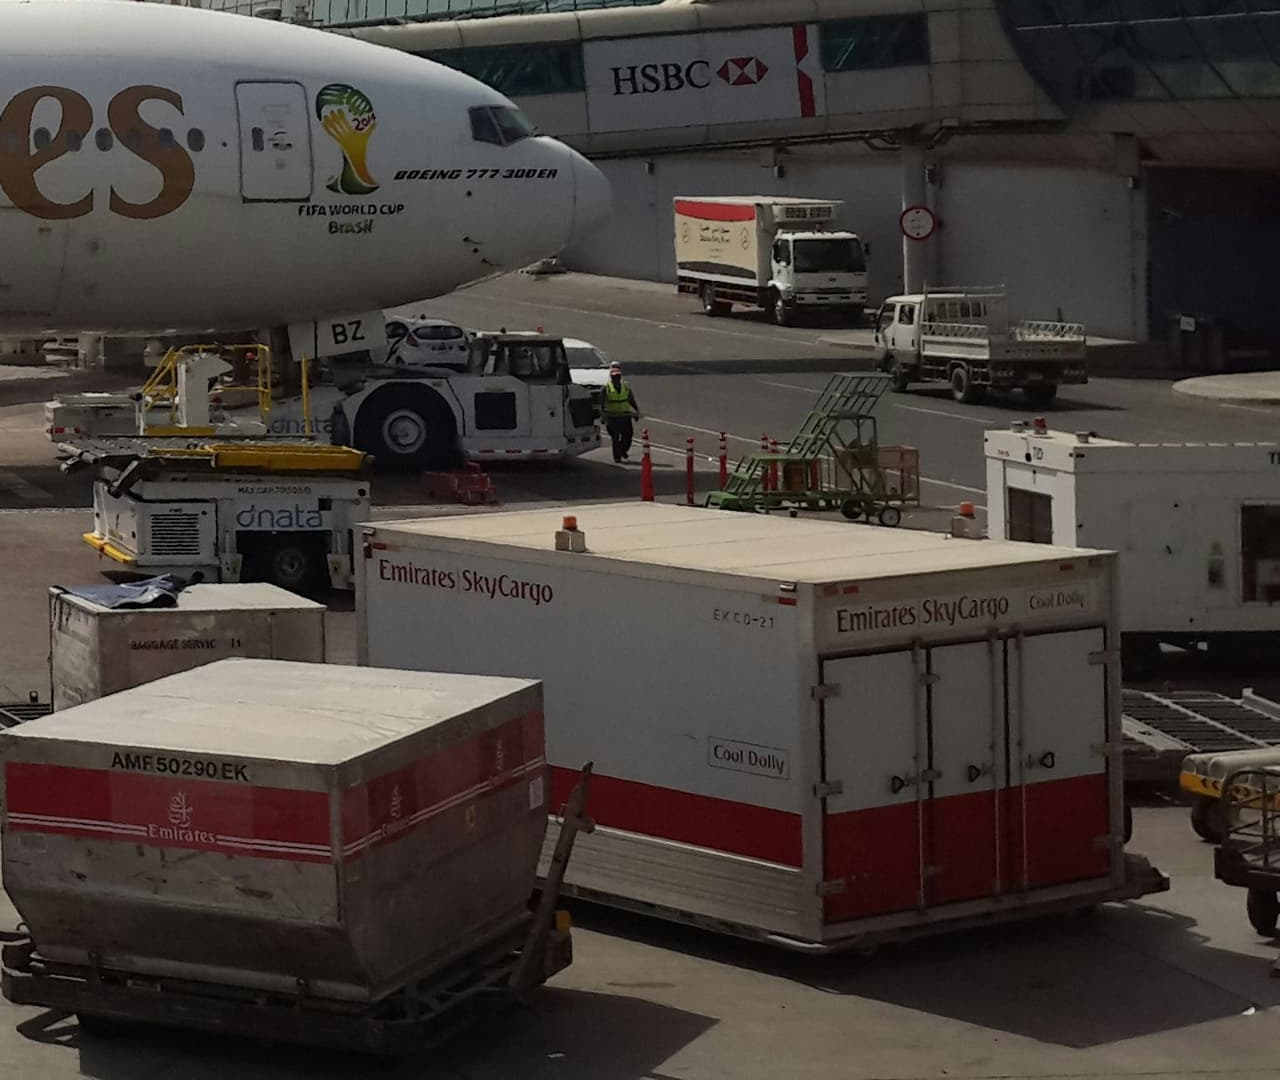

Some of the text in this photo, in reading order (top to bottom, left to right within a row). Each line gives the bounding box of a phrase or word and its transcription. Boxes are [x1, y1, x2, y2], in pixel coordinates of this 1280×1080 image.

[610, 60, 711, 95] HSBC
[394, 169, 462, 180] BOEING
[466, 169, 500, 180] 777
[298, 203, 405, 216] FIFA WORLD CUP
[328, 219, 374, 234] Brasil
[331, 319, 365, 345] BZ
[237, 504, 323, 528] dnata
[379, 559, 554, 607] Emirates SkyCargo
[1029, 595, 1054, 610] Cool
[836, 594, 1009, 633] Emirates SkyCargo
[713, 744, 784, 775] Cool Dolly
[221, 763, 249, 782] EK
[147, 824, 216, 843] Emirates
